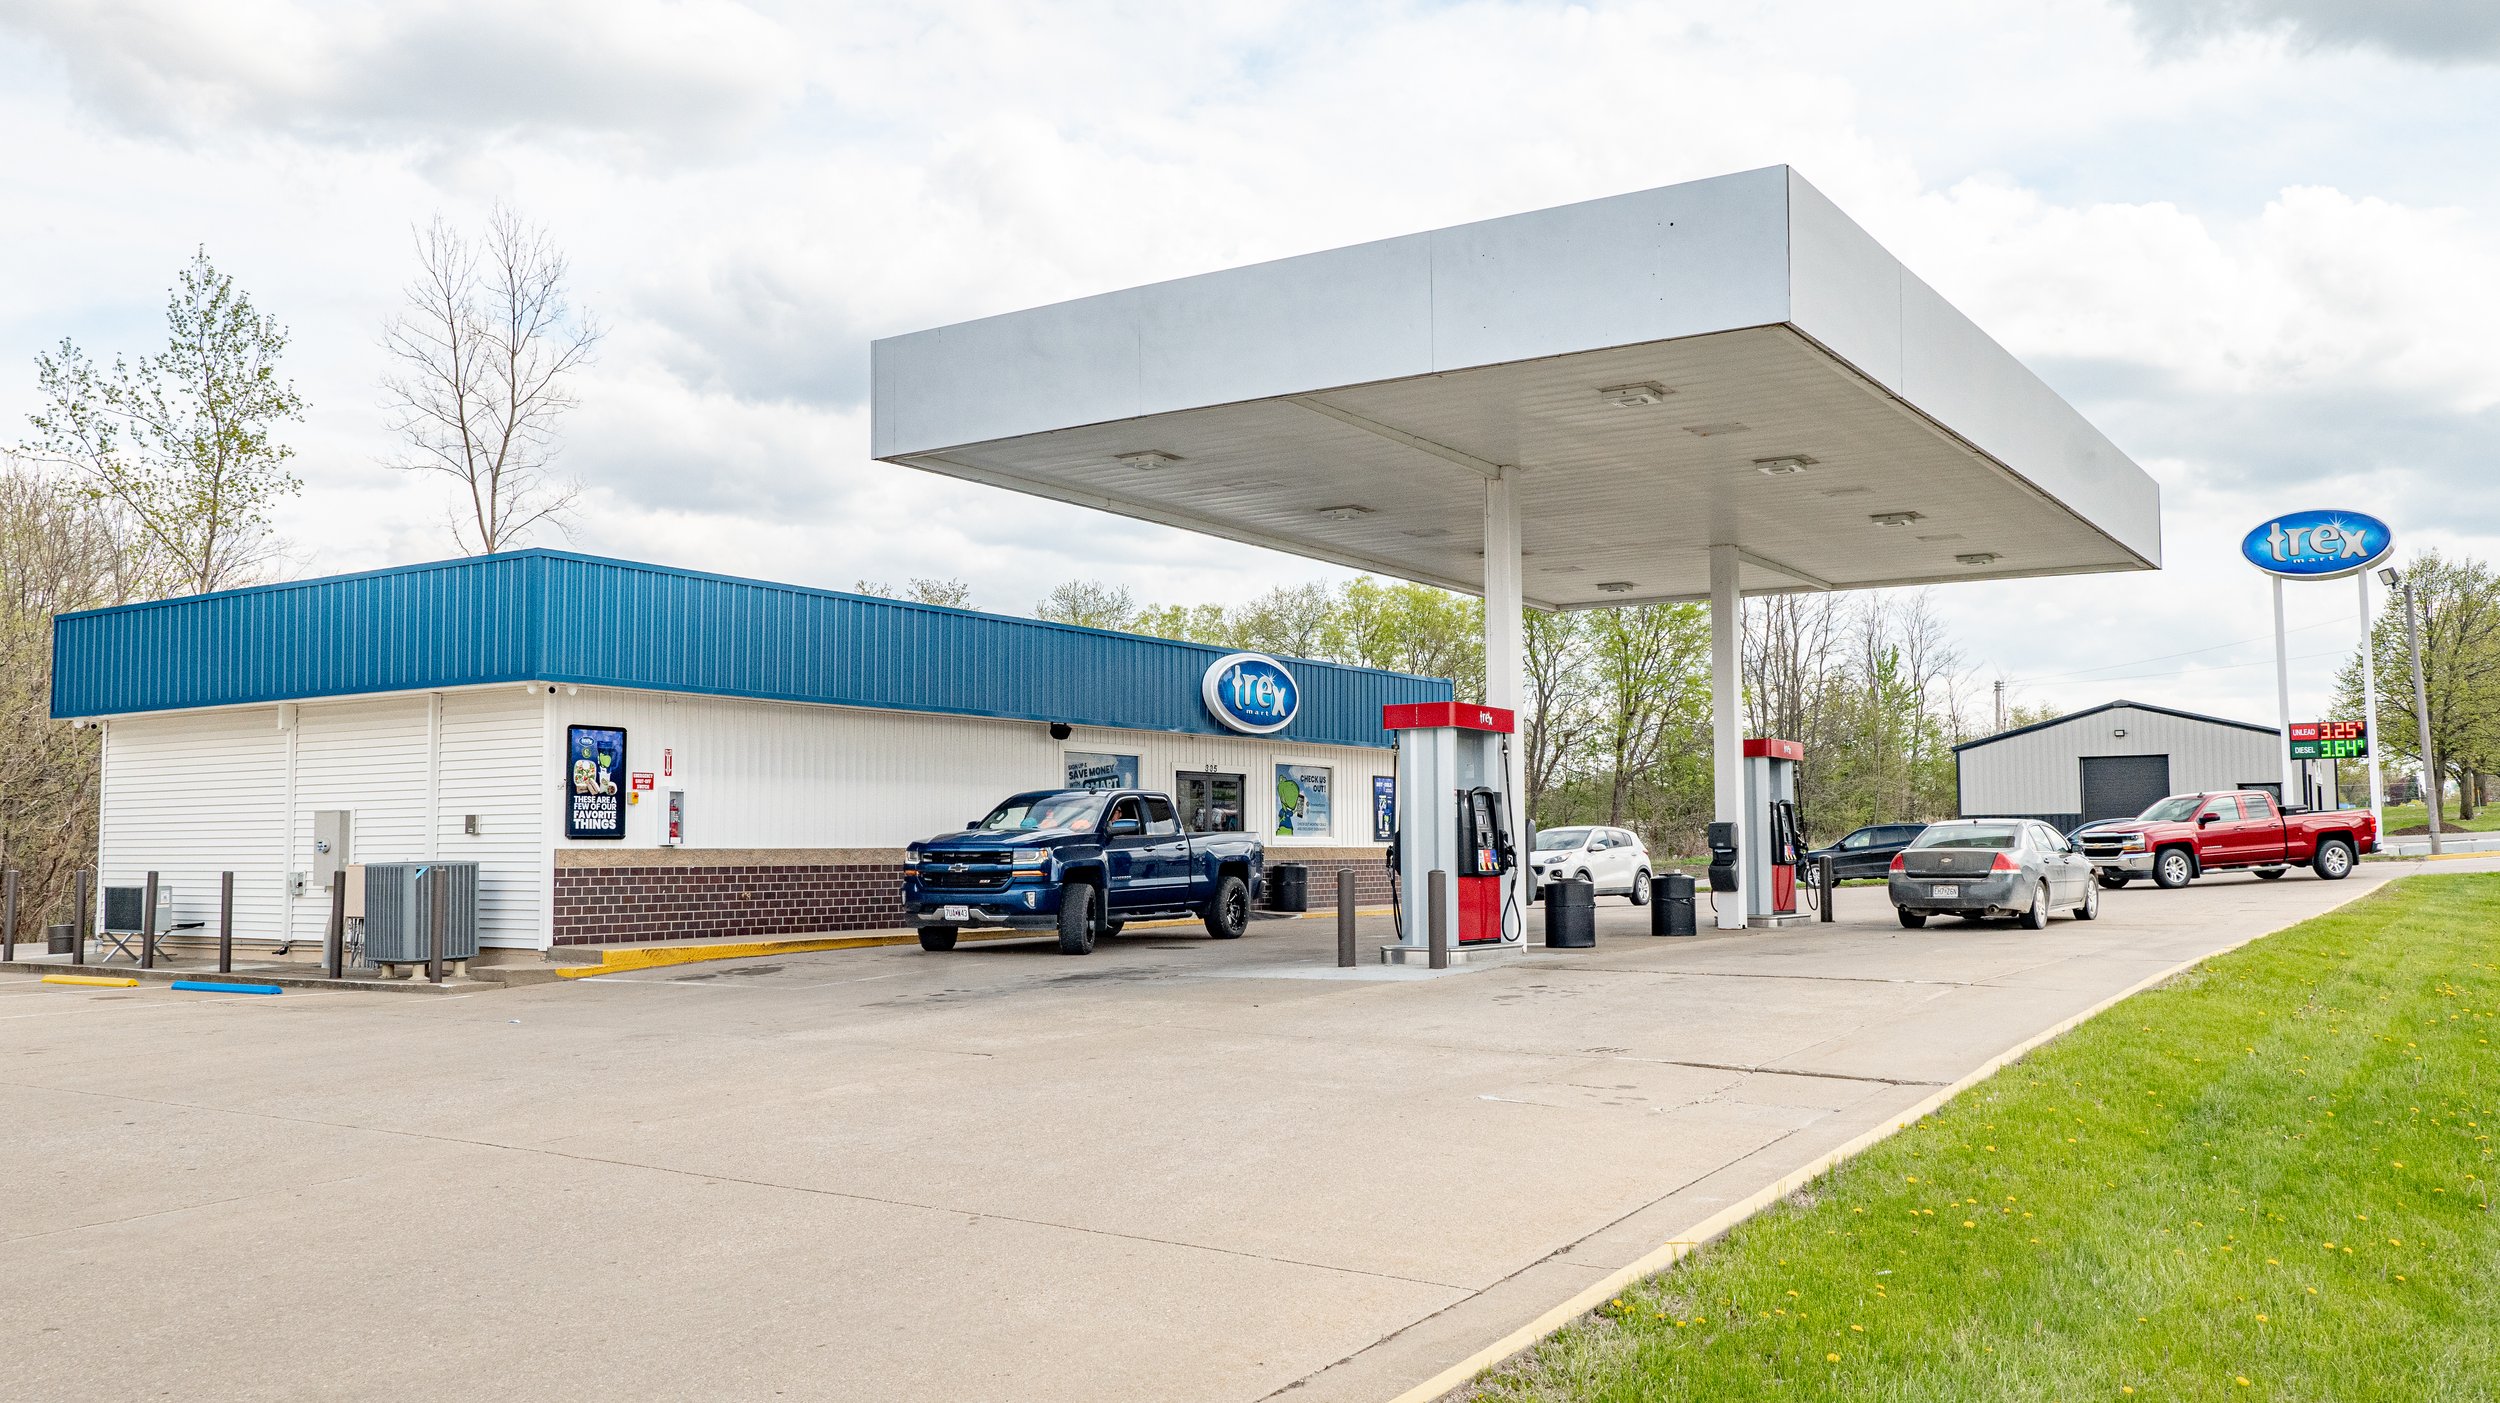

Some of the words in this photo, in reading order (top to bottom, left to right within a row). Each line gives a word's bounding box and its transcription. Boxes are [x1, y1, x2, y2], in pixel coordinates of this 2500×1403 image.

[2266, 522, 2368, 562] trex
[2293, 556, 2334, 564] mart
[1232, 665, 1286, 716] trex
[1246, 709, 1269, 717] mart
[2292, 728, 2316, 737] UNLEAD
[2294, 746, 2316, 754] DIESEL
[1069, 769, 1088, 780] SAVE
[1089, 764, 1115, 776] MONEY
[1300, 775, 1318, 783] CHECK
[1313, 785, 1327, 793] OUT!
[574, 795, 596, 803] THESE
[611, 796, 617, 804] A
[574, 810, 617, 819] FAVORITE
[573, 819, 617, 829] THINGS
